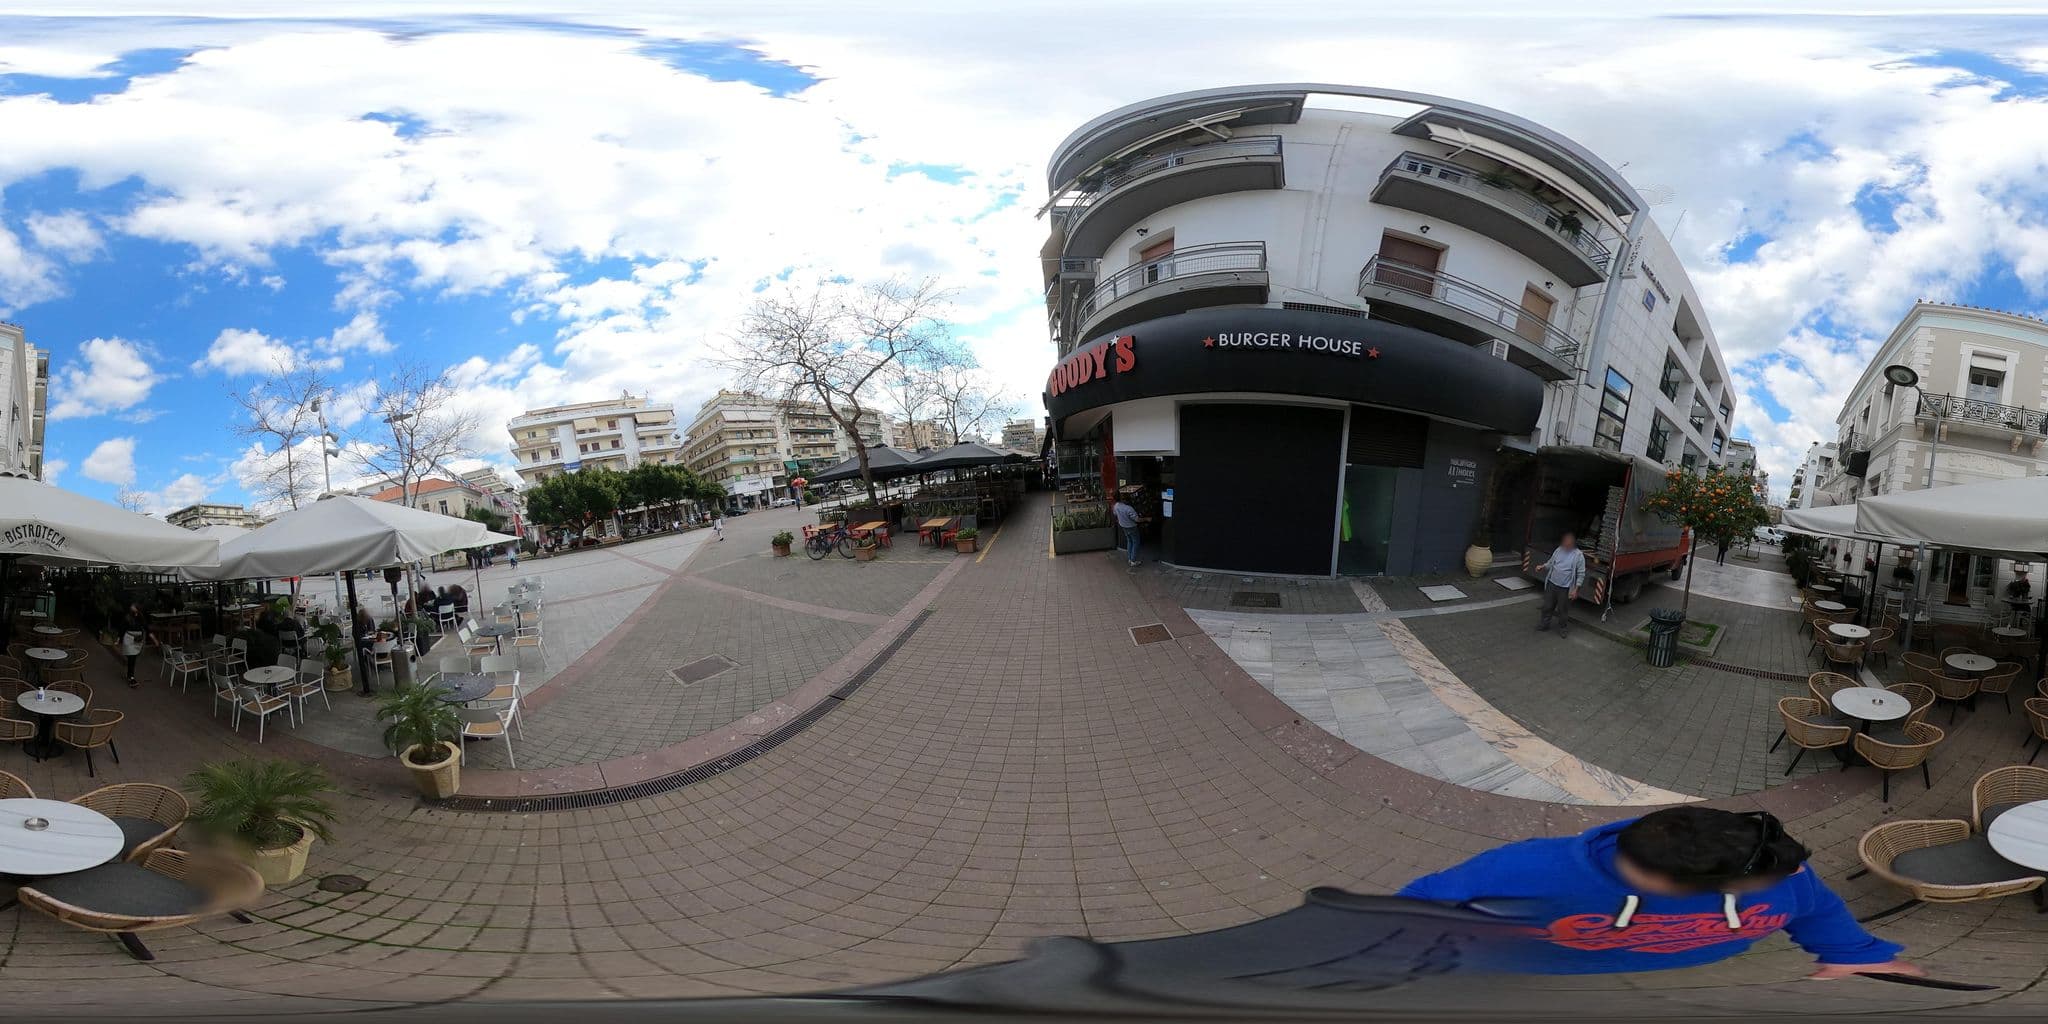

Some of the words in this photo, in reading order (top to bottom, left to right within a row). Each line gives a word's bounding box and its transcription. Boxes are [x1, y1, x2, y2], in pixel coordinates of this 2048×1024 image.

[1218, 332, 1291, 347] BURGER
[1299, 334, 1362, 356] HOUSE
[1049, 334, 1136, 398] GOODY'S
[4, 523, 66, 548] BISTROTECA
